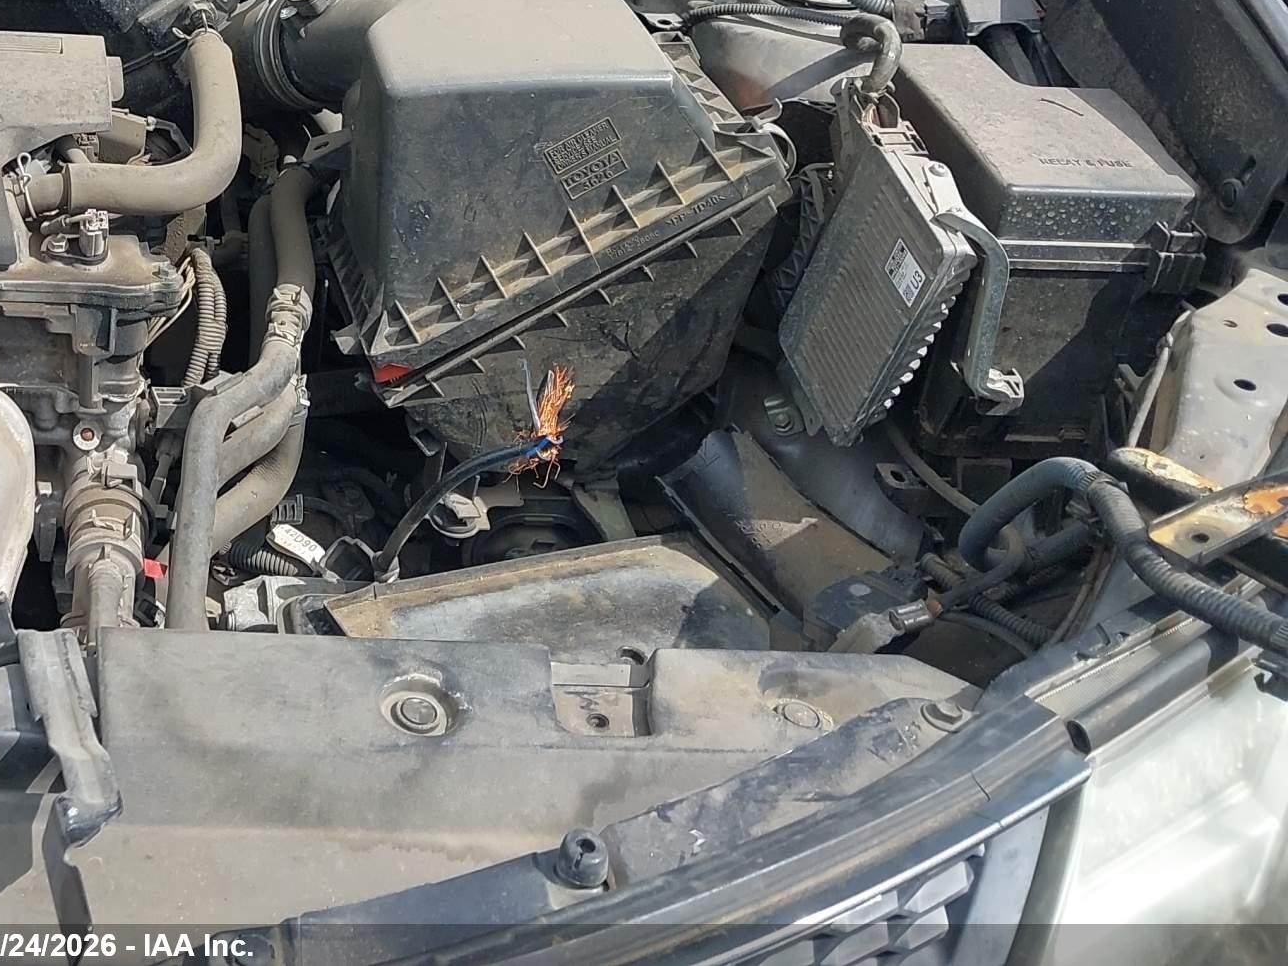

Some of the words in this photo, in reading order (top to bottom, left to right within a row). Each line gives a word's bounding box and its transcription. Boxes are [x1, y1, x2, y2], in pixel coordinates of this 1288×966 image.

[563, 152, 621, 187] TOYOTA
[1038, 158, 1081, 168] RELAY
[1085, 160, 1096, 168] &
[1097, 160, 1133, 168] FUSE
[910, 270, 923, 290] U3
